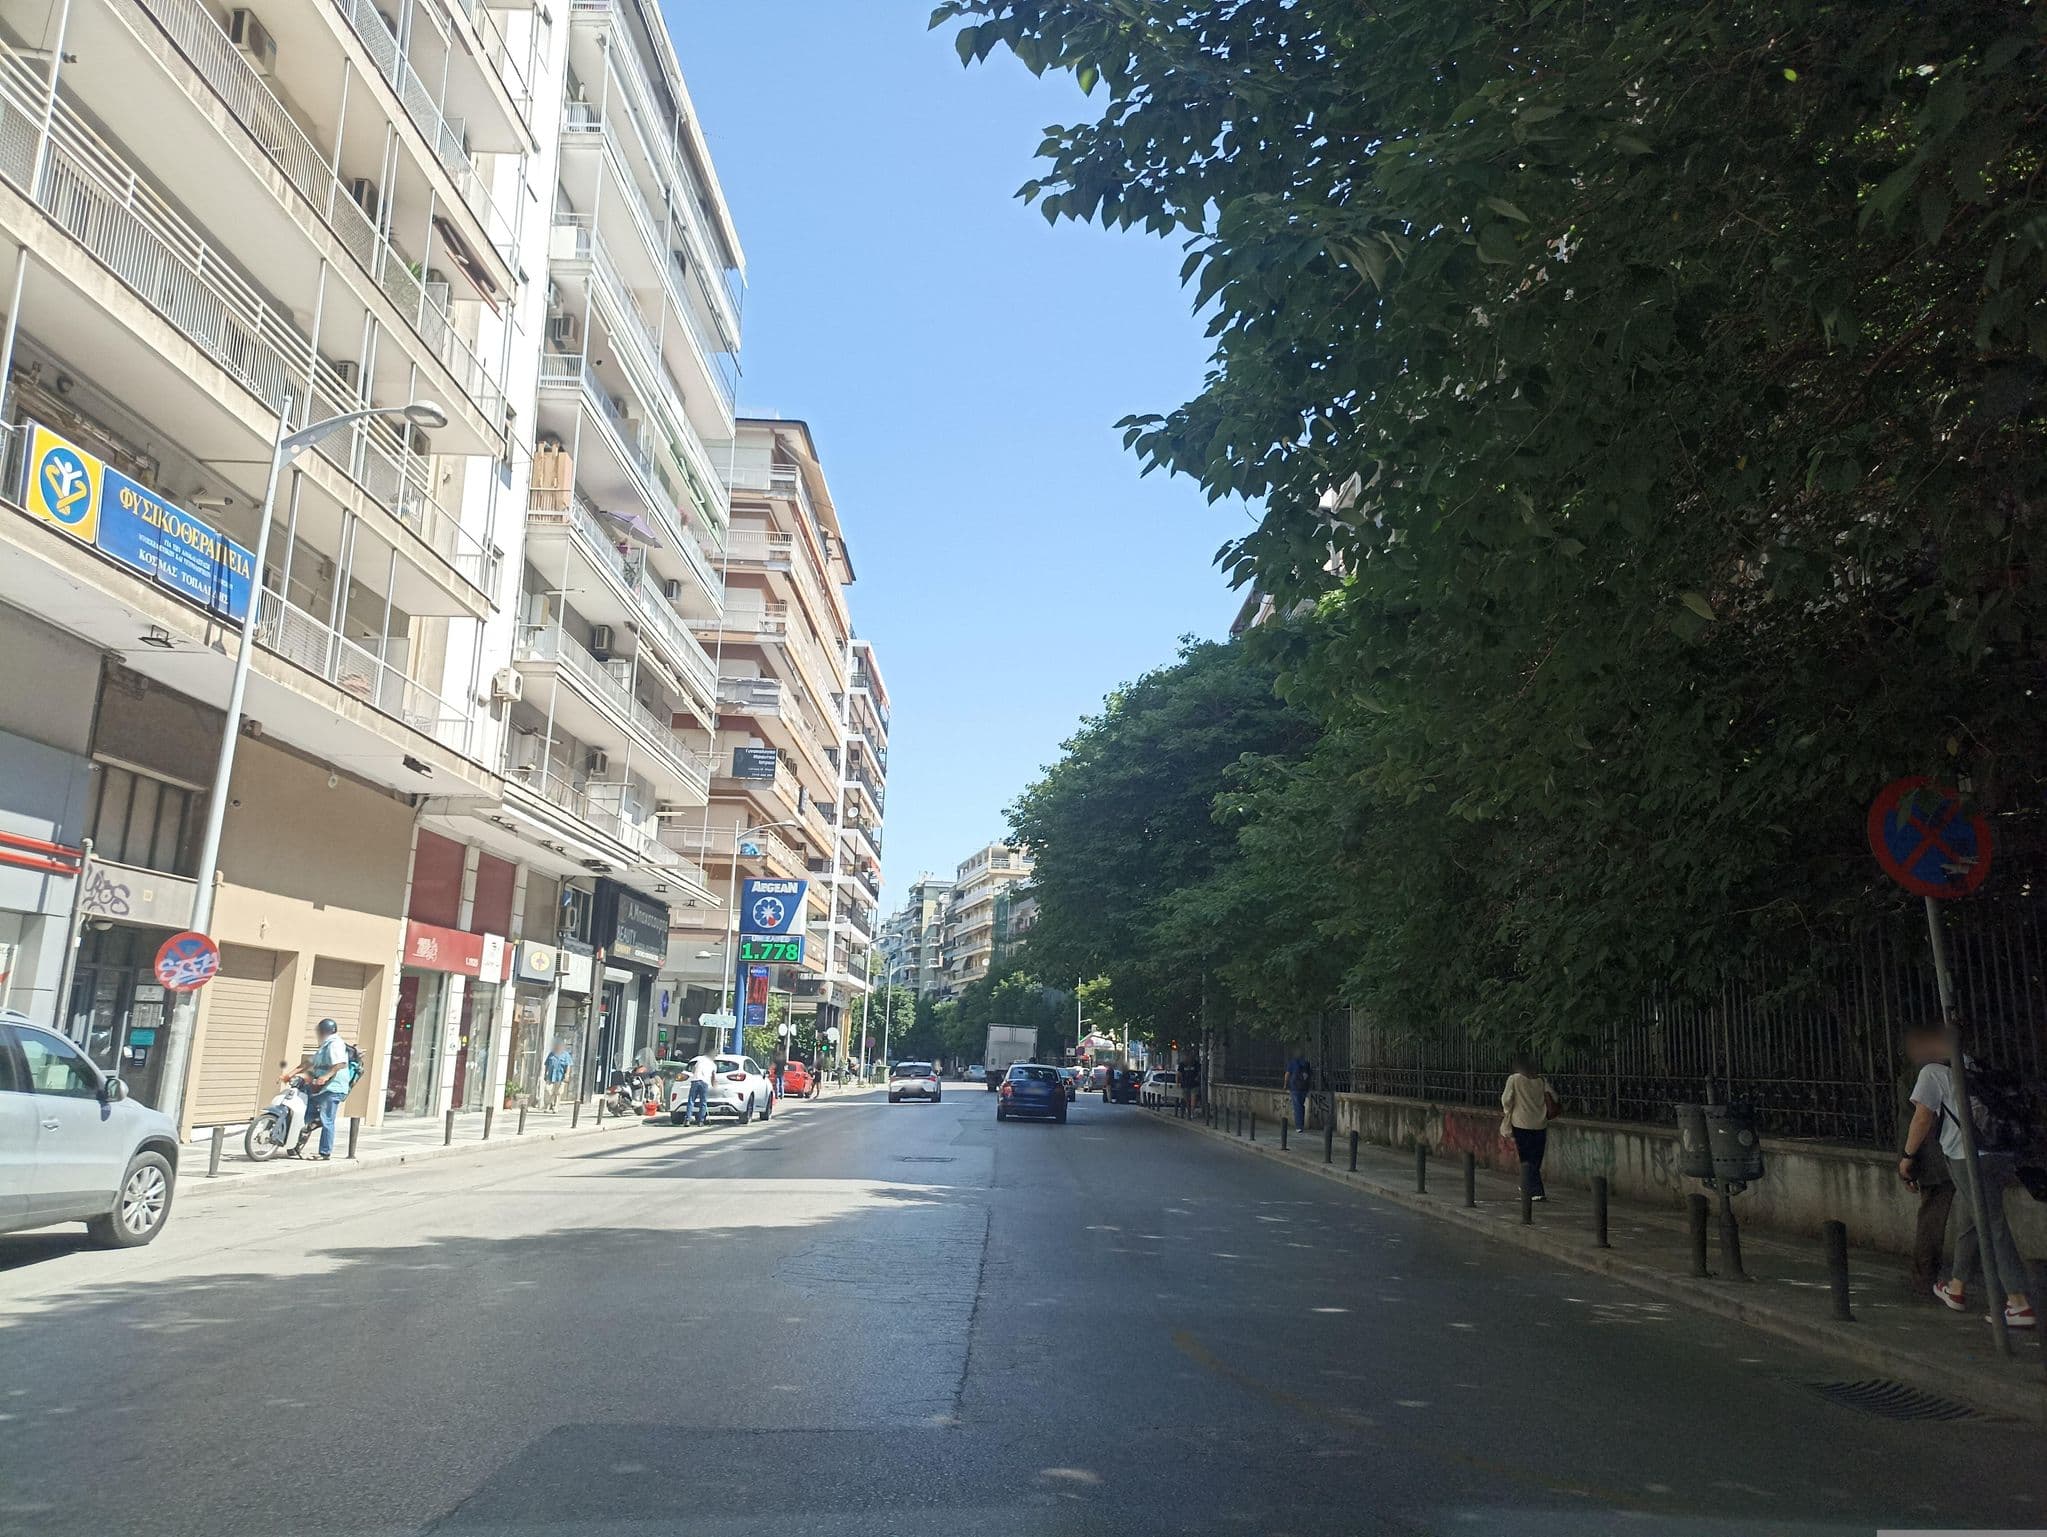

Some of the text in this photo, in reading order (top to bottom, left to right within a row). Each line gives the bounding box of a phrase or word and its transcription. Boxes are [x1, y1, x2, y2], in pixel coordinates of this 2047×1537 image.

[119, 487, 250, 580] ΦΥΣΙΚΟΘΕΡΑΠΕΙΑ
[138, 548, 178, 578] ΚΟΣΜΑΣ
[751, 881, 798, 894] AEGEAN
[742, 943, 798, 960] 1.778
